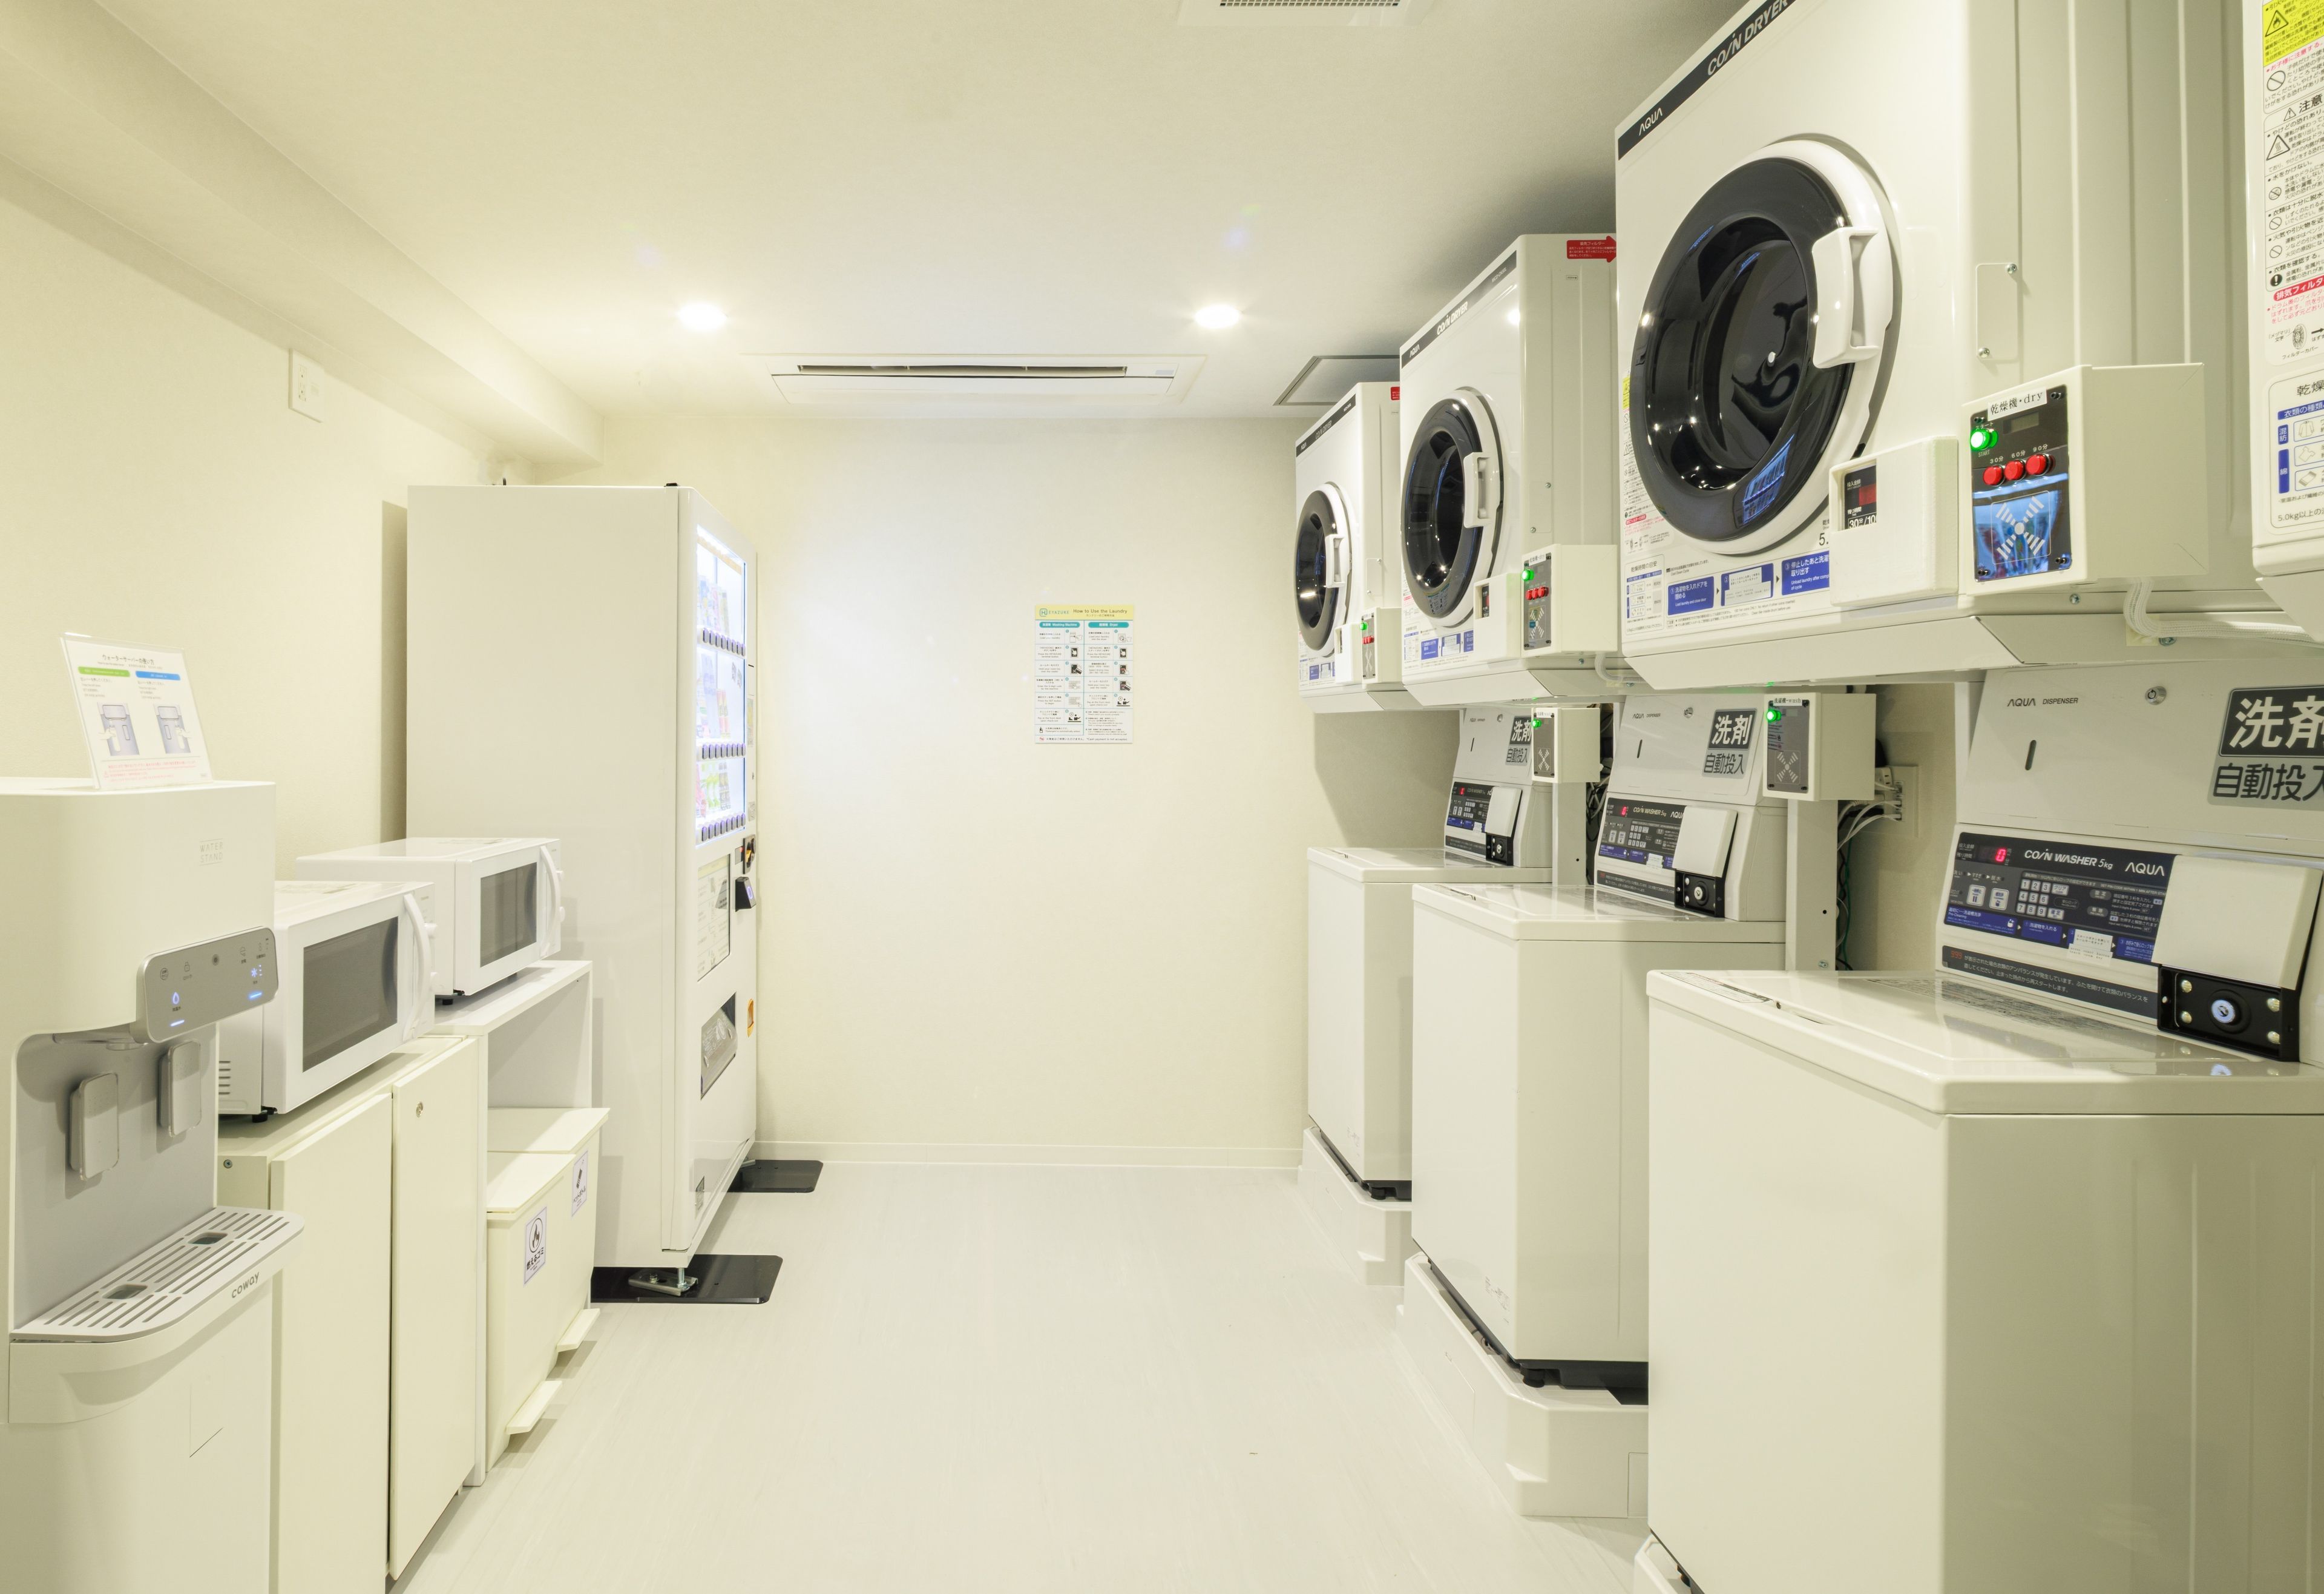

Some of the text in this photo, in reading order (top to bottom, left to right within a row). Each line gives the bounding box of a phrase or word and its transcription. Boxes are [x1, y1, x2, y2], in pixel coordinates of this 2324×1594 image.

[2299, 93, 2322, 113] 注意
[1638, 107, 1663, 136] AQUA
[2274, 253, 2320, 272] 衣類を確認する。
[1450, 301, 1468, 324] DRYER
[1410, 344, 1420, 358] AQUA
[2282, 346, 2319, 360] フィルターカバー
[1990, 392, 2043, 415] 乾燥機・dry
[1975, 421, 1994, 430] スタート
[1989, 443, 2048, 464] 30分 60分 90分
[1849, 515, 1876, 529] 30分/10
[1631, 561, 1658, 573] 乾燥時間の目安
[1791, 554, 1830, 569] 停止したあと洗濯
[1791, 567, 1809, 577] 取り出す
[1675, 581, 1708, 594] 洗濯物を入れドアを
[2007, 697, 2079, 707] AQUA DISPENSER
[1511, 719, 1532, 742] 洗剤
[1711, 714, 1753, 745] 洗剤
[2228, 695, 2324, 749] 洗剤
[1506, 748, 1528, 763] 自動投入
[1703, 753, 1744, 775] 自動投入
[2212, 763, 2324, 802] 自動投入
[199, 841, 223, 852] WATER
[1995, 848, 2006, 862] 0
[200, 852, 223, 863] STAND
[2024, 849, 2165, 877] COIN WASHER 5kg AQUA
[2029, 922, 2057, 932] 洗濯物を入れる
[527, 1247, 544, 1270] 燃えるゴミ
[231, 1271, 260, 1299] coway
